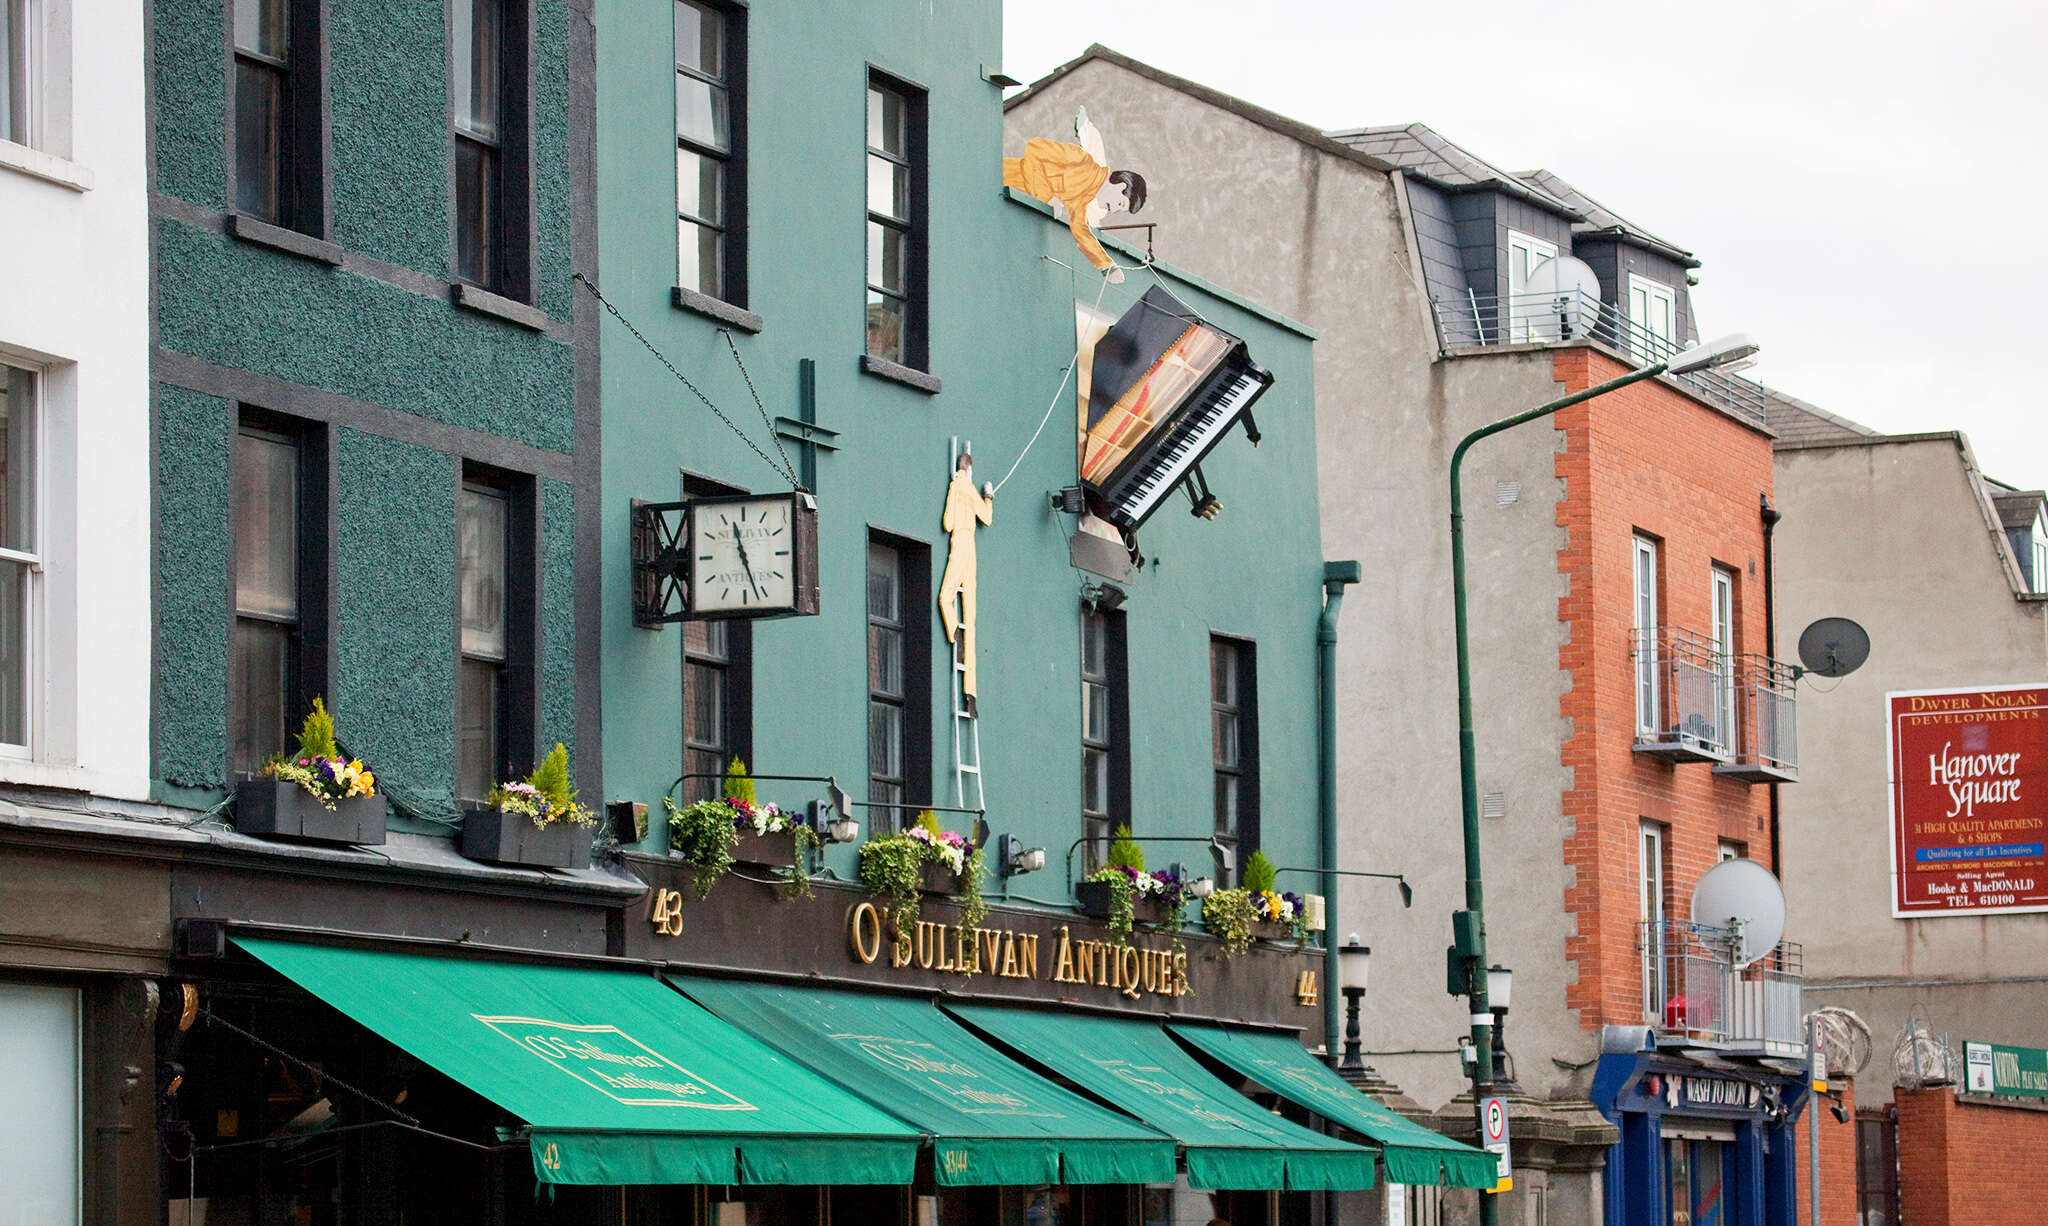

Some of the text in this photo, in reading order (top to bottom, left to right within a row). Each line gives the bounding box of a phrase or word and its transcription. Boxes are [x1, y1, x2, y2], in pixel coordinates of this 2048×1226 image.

[1911, 692, 2038, 712] DWYER NOLAN
[1911, 710, 2039, 726] DEVELOPMENTS
[1929, 741, 2021, 785] Hanover
[1946, 778, 2022, 817] Square
[1924, 821, 1947, 833] HIGH
[1948, 820, 1985, 834] QUALITY
[1987, 818, 2043, 831] APARTMENTS
[1975, 832, 2002, 843] SHOPS
[1986, 846, 1998, 856] Tax
[1928, 878, 2035, 897] Hooke & MacDONALD
[652, 888, 683, 936] 43
[1980, 894, 2016, 907] 610100
[1298, 970, 1318, 1006] 44
[587, 1066, 707, 1098] Antiques
[1687, 1078, 1711, 1103] WASH
[1712, 1080, 1725, 1105] TO
[543, 1143, 560, 1169] 42
